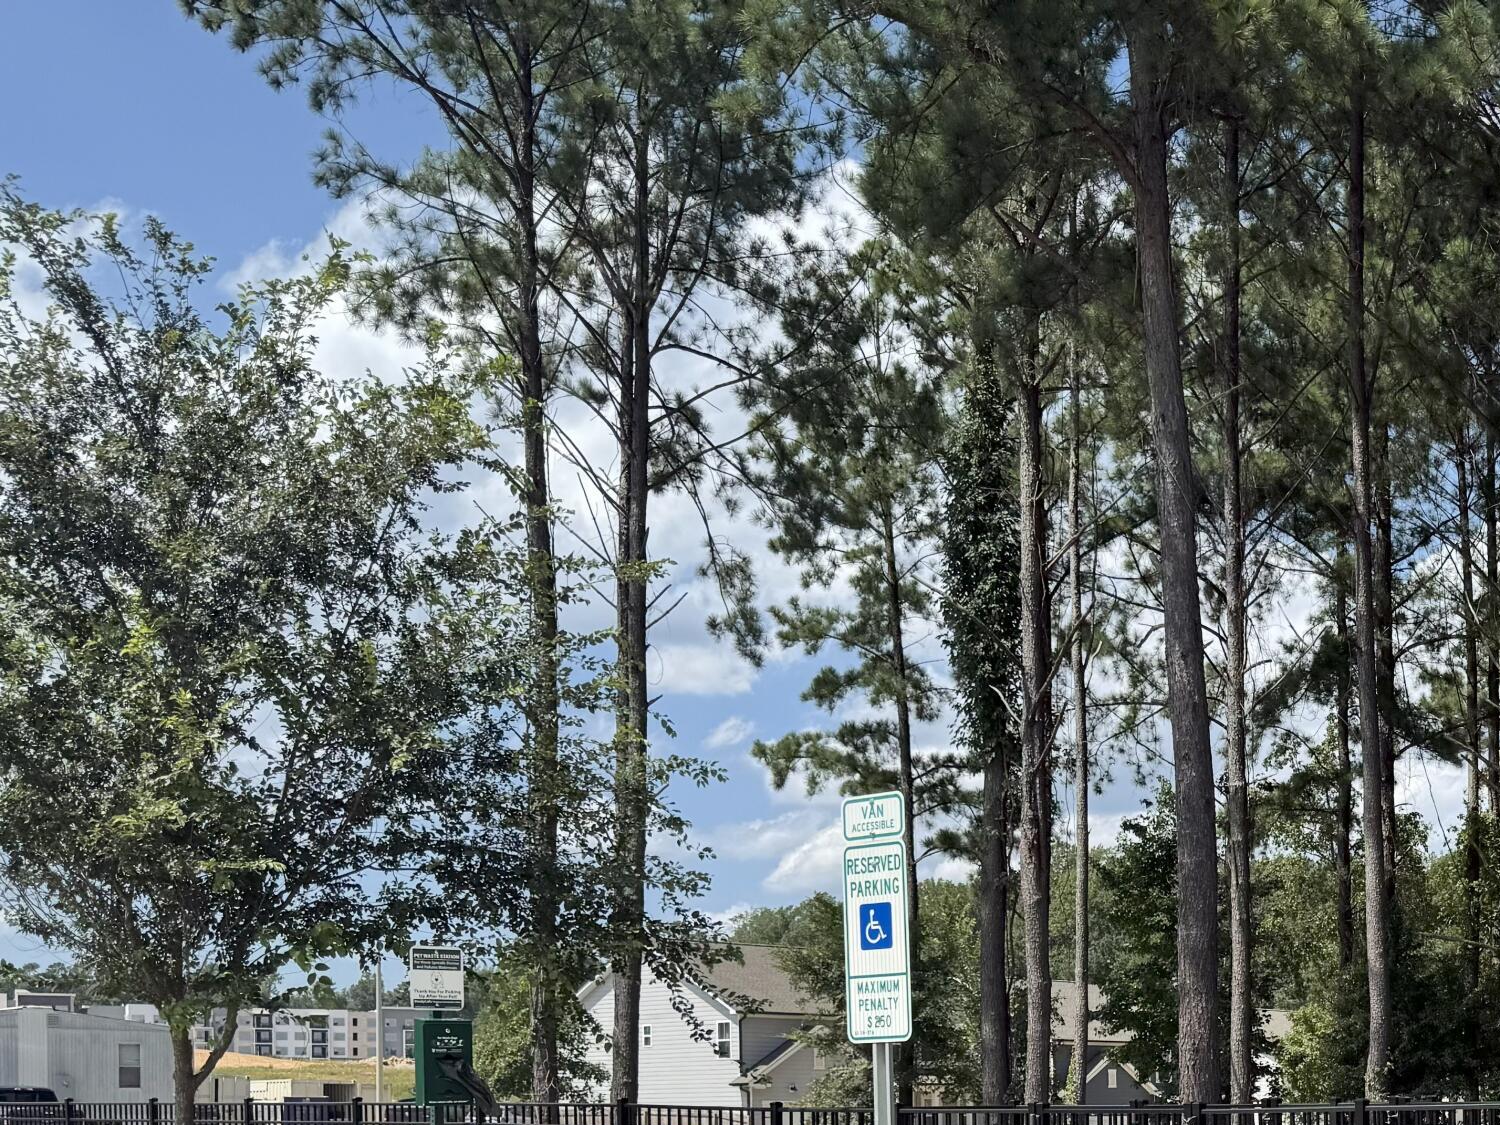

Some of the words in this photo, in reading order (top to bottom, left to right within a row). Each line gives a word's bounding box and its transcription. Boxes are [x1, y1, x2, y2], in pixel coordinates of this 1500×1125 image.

[861, 803, 884, 819] VAN
[851, 818, 895, 833] ACCESSIBLE
[847, 854, 901, 876] RESERVED
[850, 877, 900, 898] PARKING
[857, 979, 900, 994] MAXIMUM
[858, 997, 899, 1011] PENALTY
[867, 1015, 892, 1028] $250
